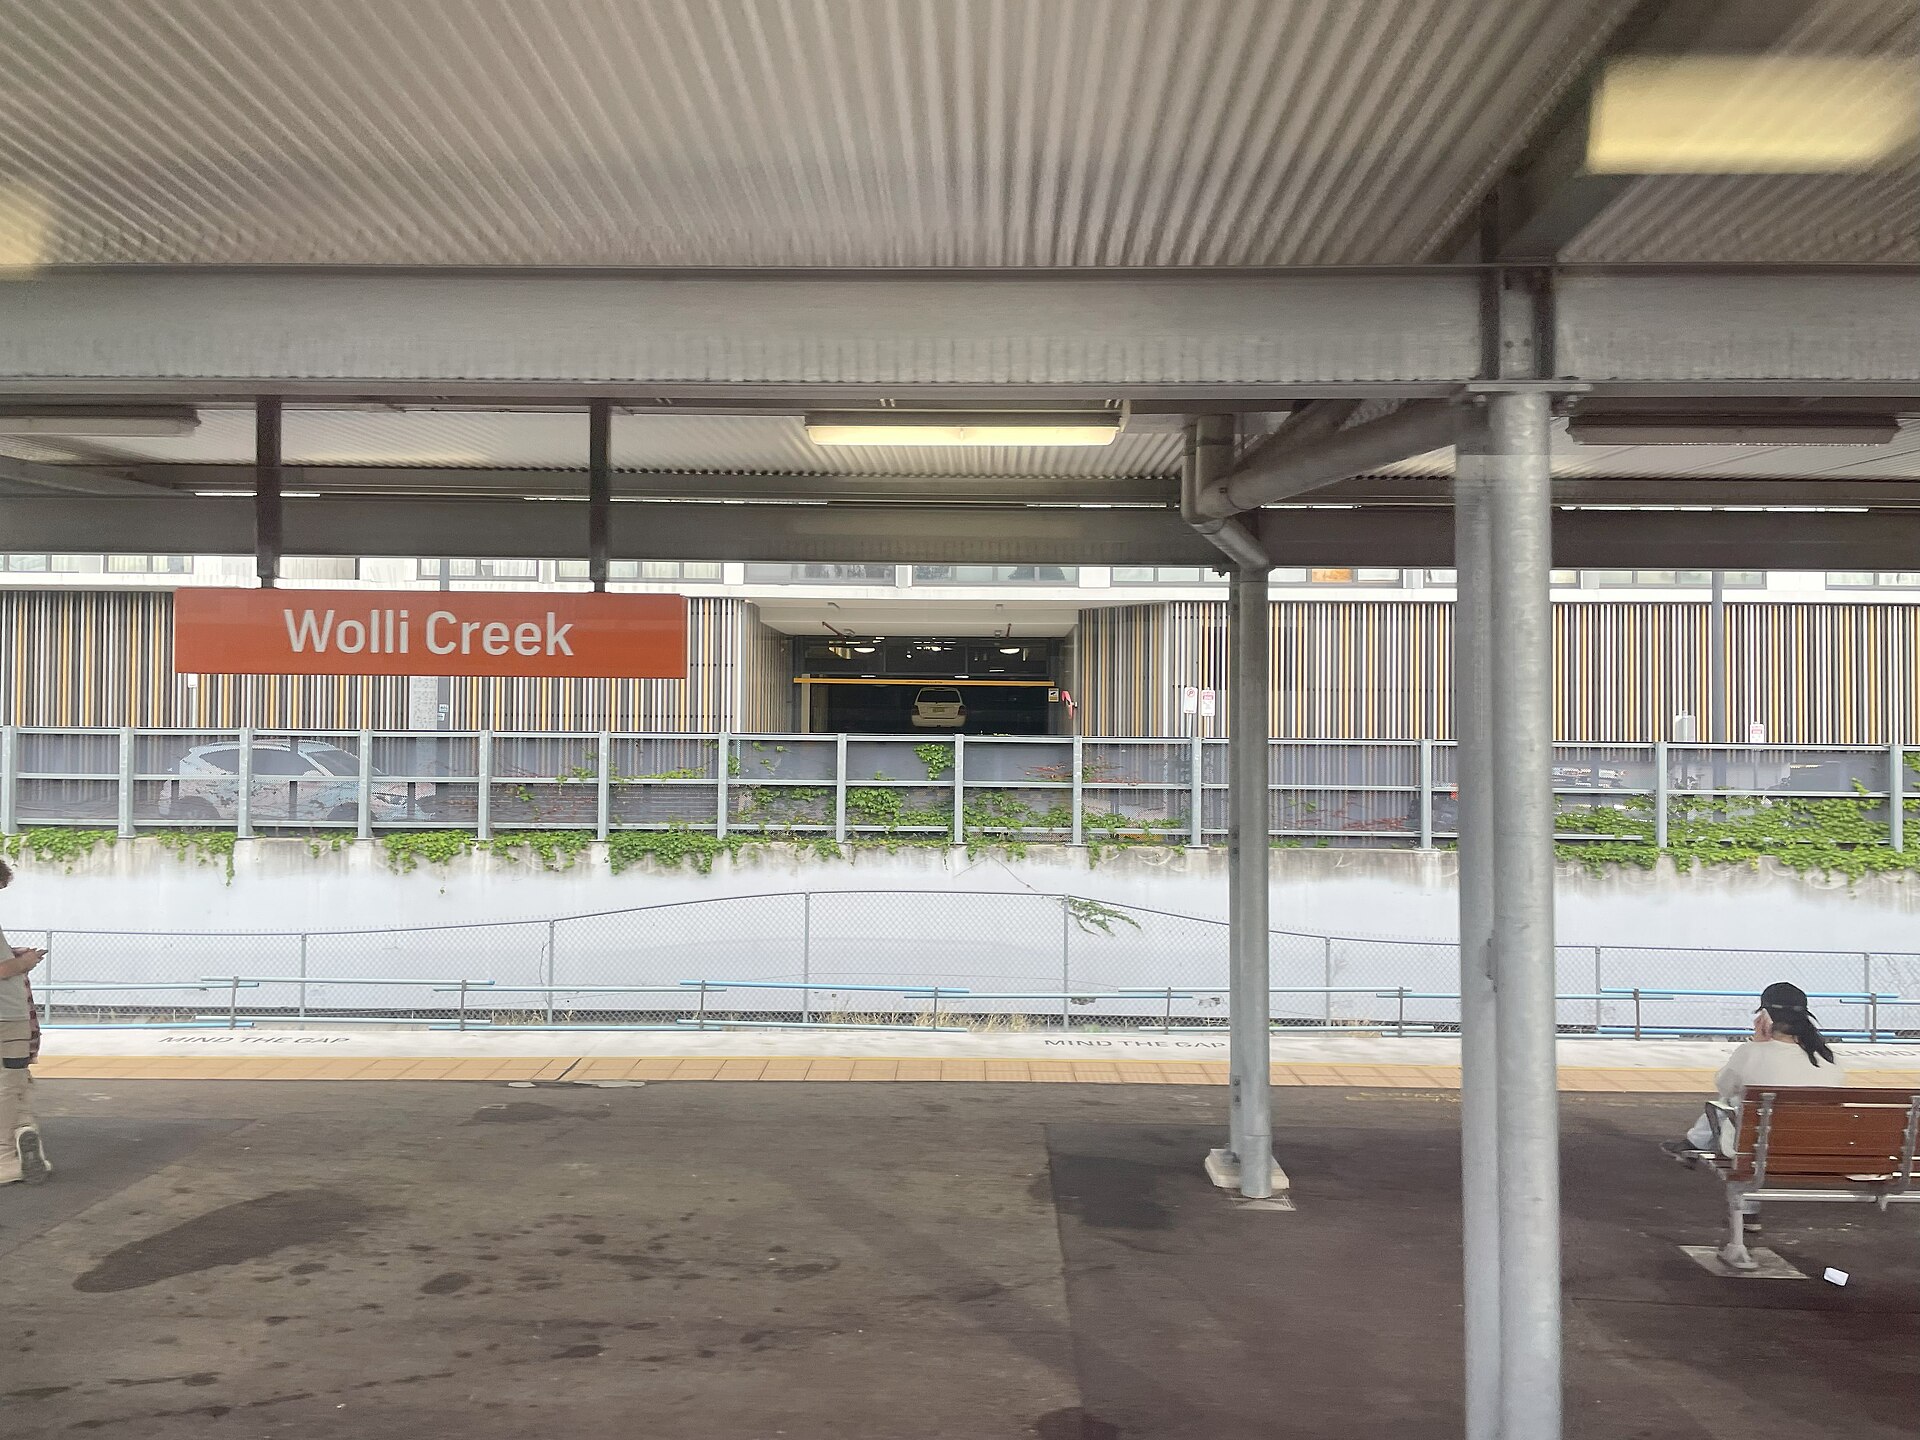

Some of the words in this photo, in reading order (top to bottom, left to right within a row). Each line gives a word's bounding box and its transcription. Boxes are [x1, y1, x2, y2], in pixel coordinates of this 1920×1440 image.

[283, 609, 409, 654] Wolli
[426, 611, 575, 656] Creek
[158, 1036, 234, 1044] MIND
[1044, 1039, 1112, 1047] MIND
[1117, 1040, 1170, 1048] THE
[1175, 1041, 1227, 1049] GAP
